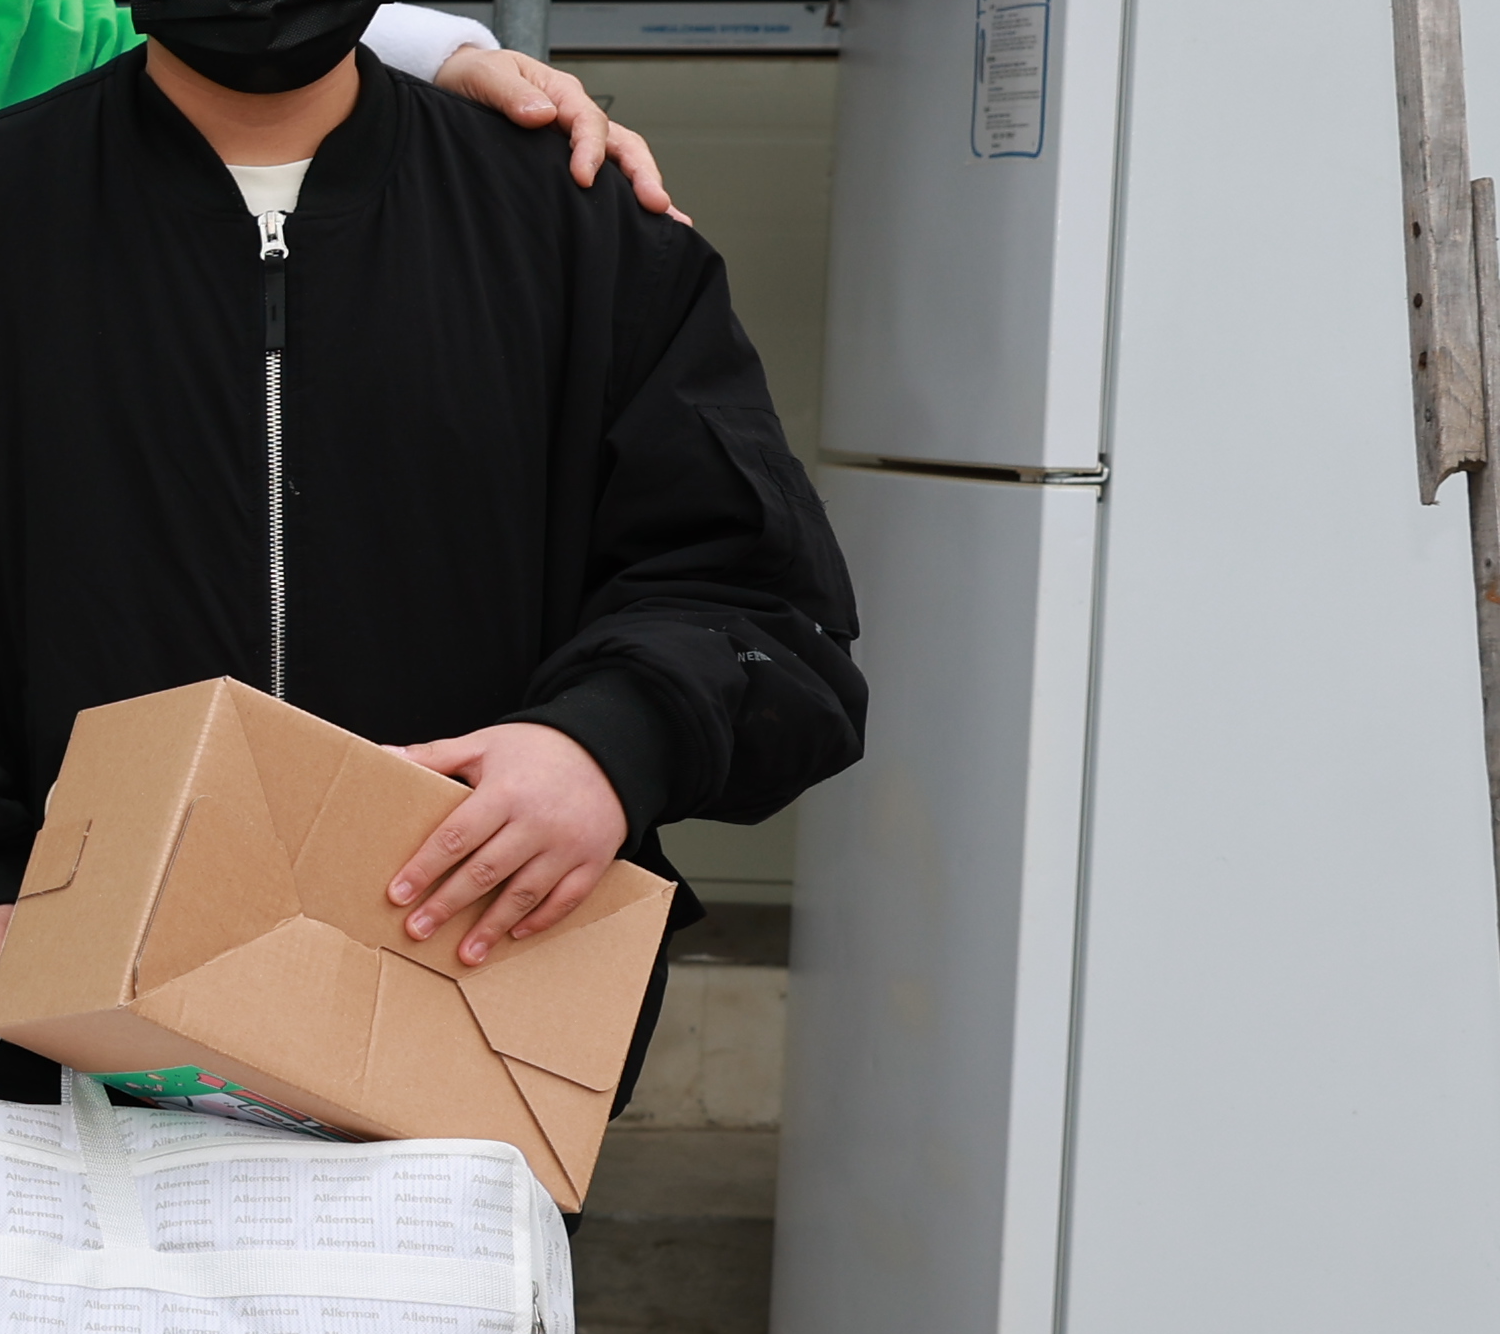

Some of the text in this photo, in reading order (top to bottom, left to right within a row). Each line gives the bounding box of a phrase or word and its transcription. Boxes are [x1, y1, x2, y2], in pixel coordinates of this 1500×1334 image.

[154, 1177, 211, 1192] Allerman
[313, 1193, 372, 1204] Allerman
[395, 1239, 456, 1255] Allerman
[84, 1321, 143, 1334] Allerman
